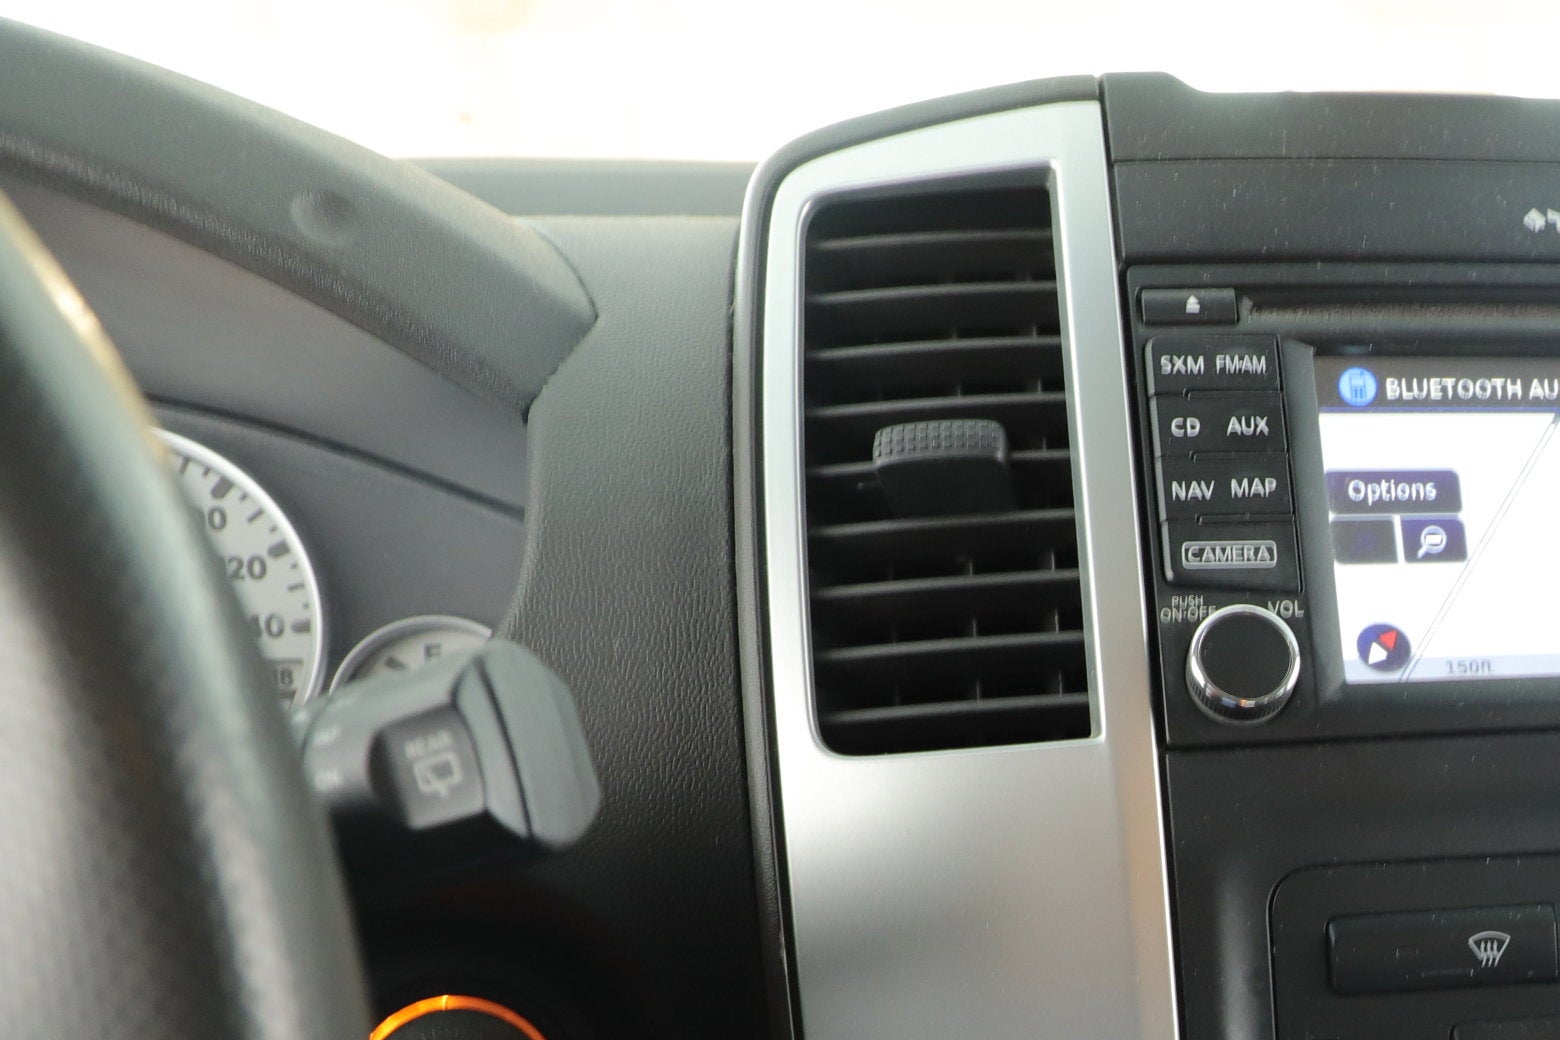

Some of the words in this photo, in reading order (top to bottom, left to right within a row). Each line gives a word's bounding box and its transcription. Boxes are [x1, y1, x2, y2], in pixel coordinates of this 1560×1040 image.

[1160, 355, 1204, 375] SXM
[1385, 377, 1523, 401] BLUETOOTH
[1170, 417, 1200, 438] CD
[1226, 416, 1270, 437] AUX
[1171, 480, 1215, 502] NAV
[1230, 477, 1277, 498] MAP
[1348, 479, 1438, 506] Options
[1187, 543, 1271, 564] CAMERA
[1171, 595, 1204, 609] PUSH
[1267, 600, 1304, 619] VOL
